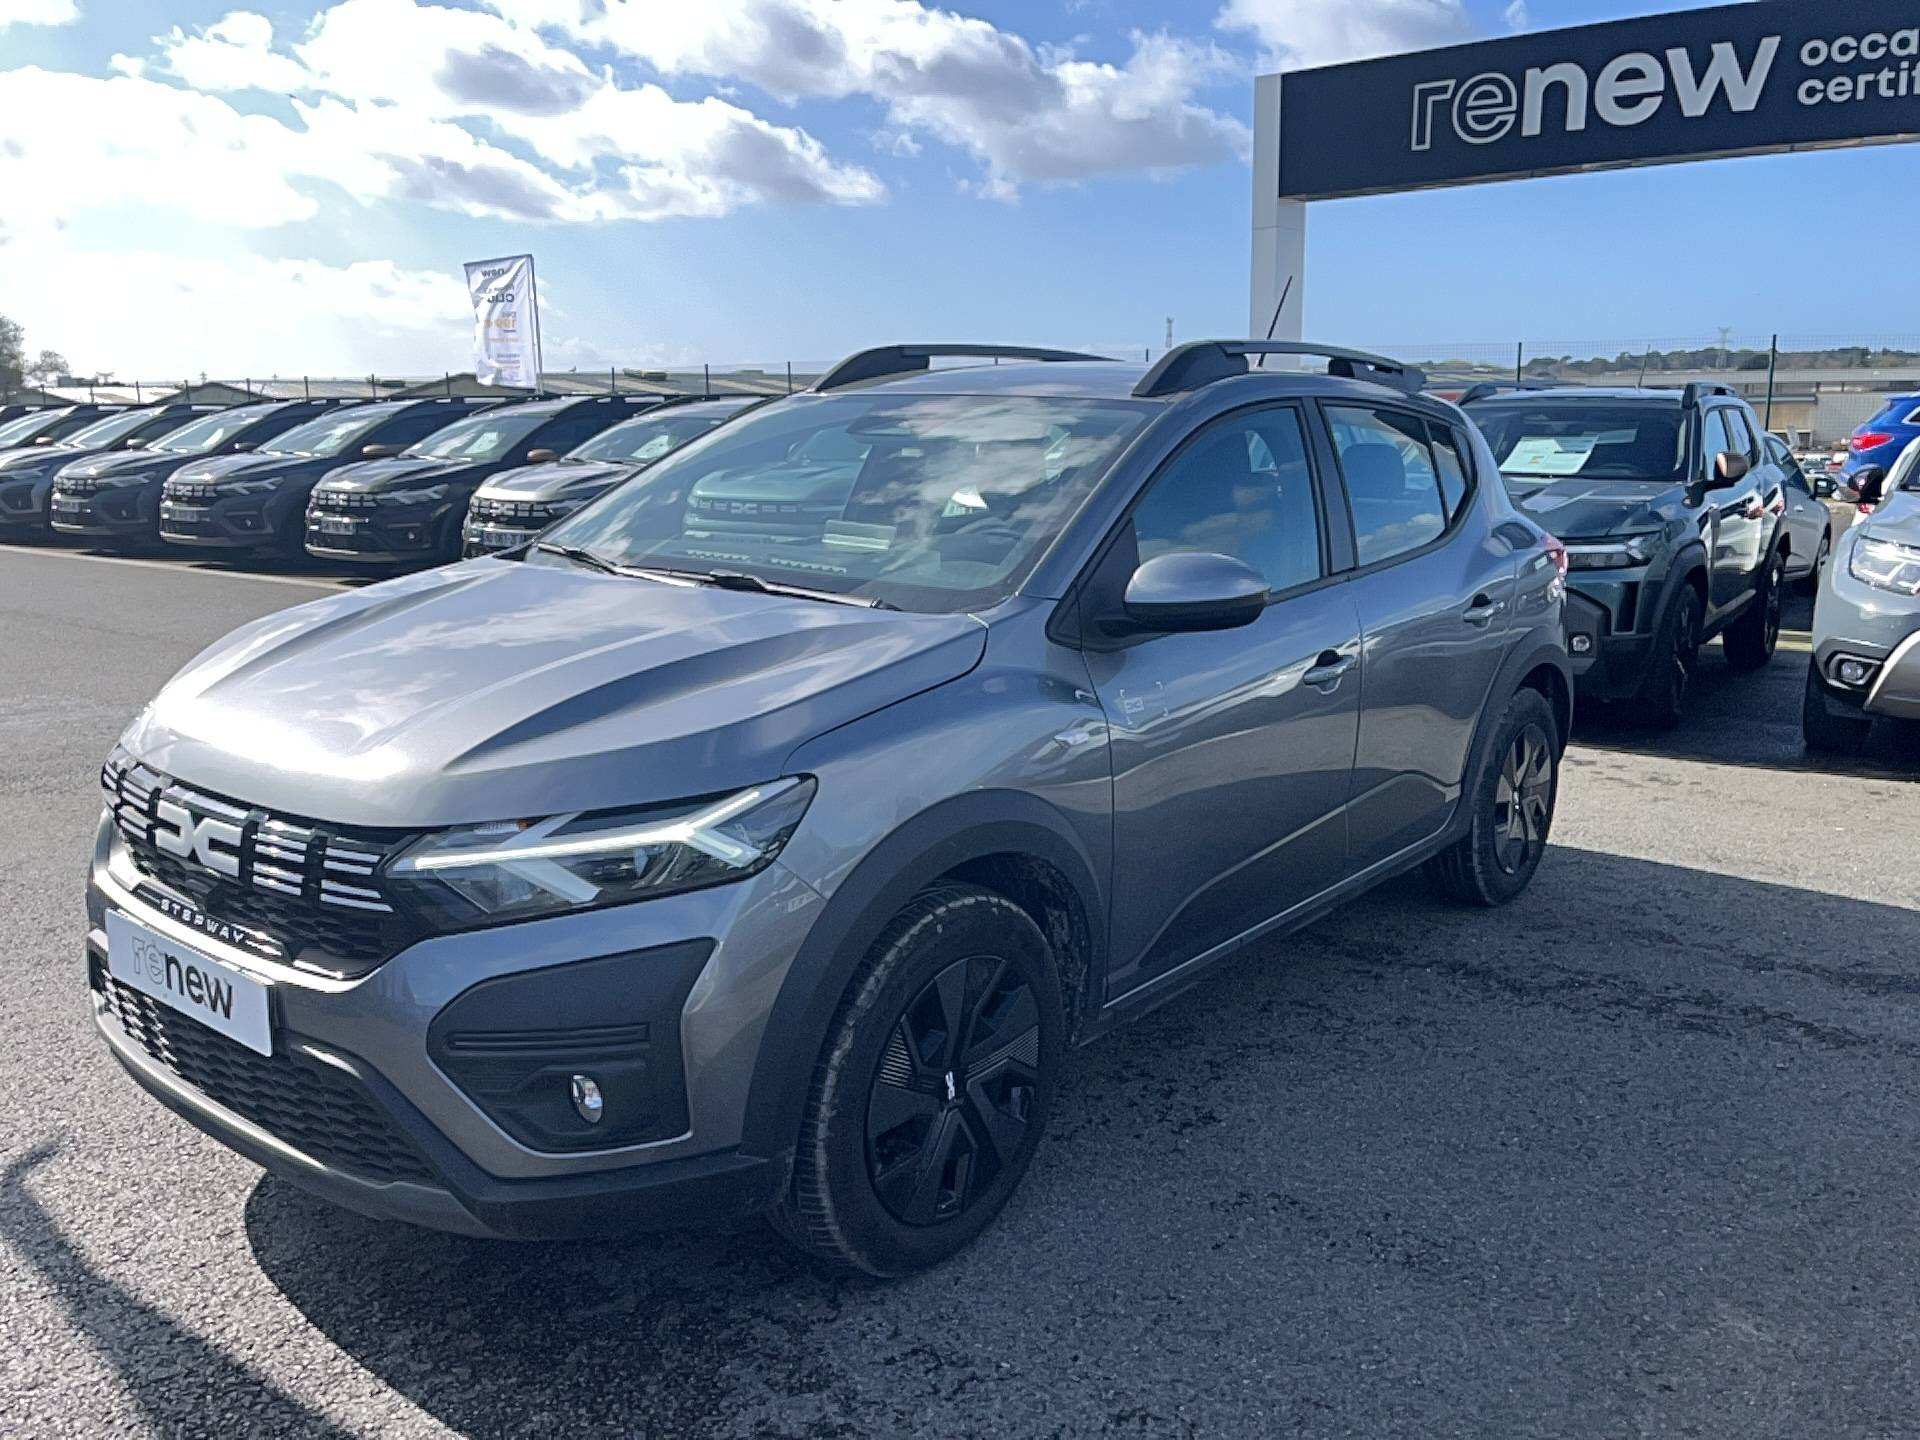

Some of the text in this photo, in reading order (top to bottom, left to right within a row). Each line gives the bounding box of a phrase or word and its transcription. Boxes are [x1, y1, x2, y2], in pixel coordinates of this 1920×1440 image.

[1800, 28, 1920, 66] occa
[1410, 35, 1782, 151] renew
[131, 935, 233, 1021] renew
